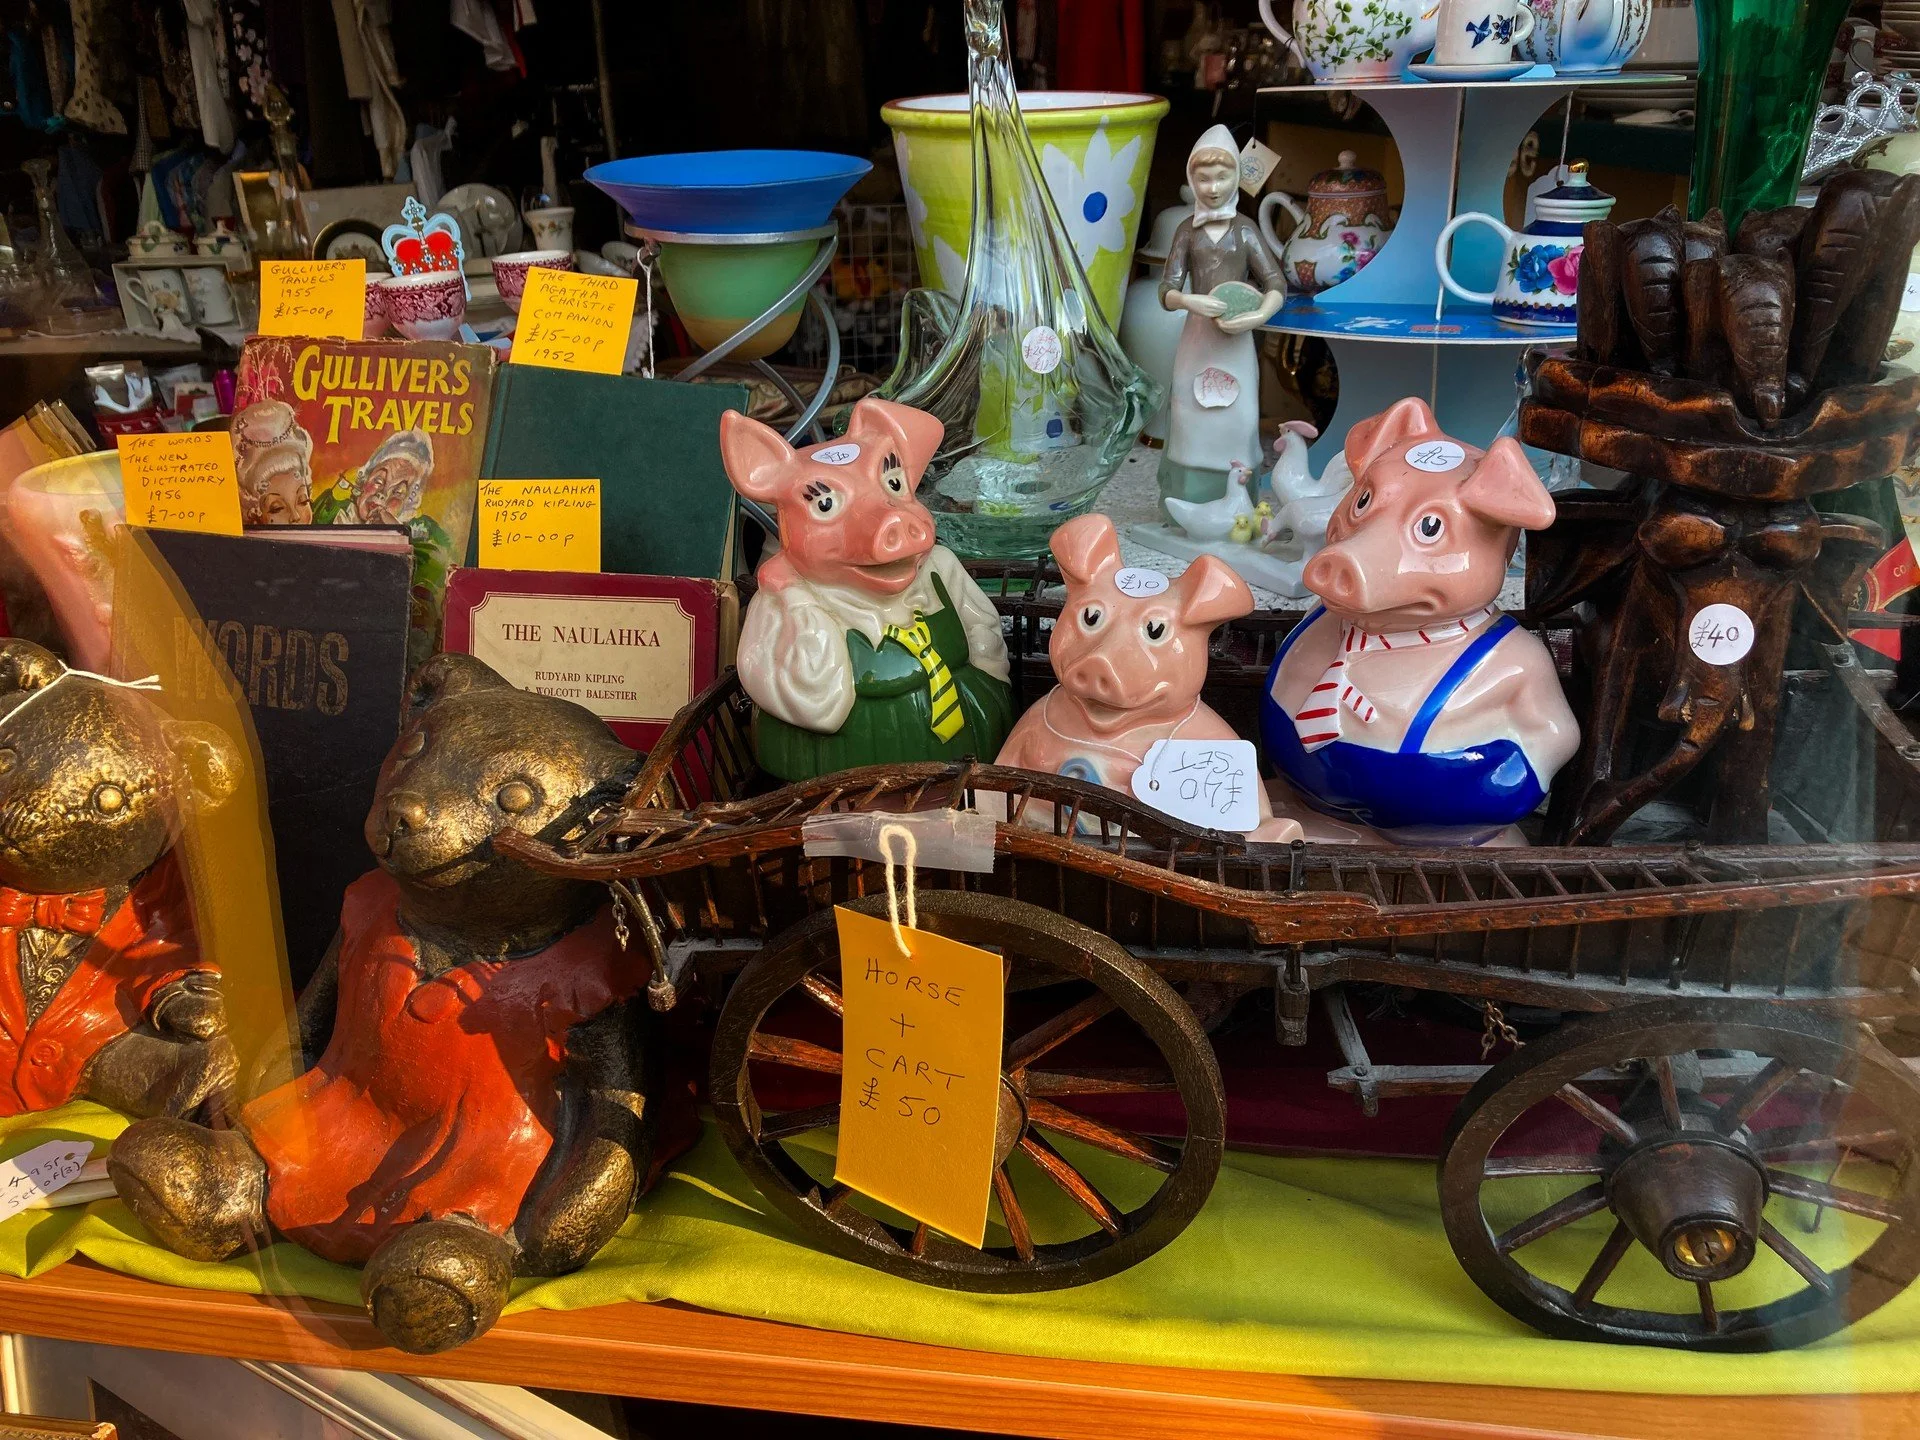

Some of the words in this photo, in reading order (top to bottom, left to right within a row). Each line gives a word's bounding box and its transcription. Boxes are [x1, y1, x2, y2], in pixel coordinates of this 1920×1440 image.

[271, 262, 346, 274] GULLIVER'S
[279, 274, 335, 284] TRAVELS
[538, 272, 566, 281] THE
[580, 276, 618, 290] THIRD
[281, 286, 315, 297] 1955
[540, 283, 599, 299] AGATHA
[273, 302, 333, 319] £15-00p
[549, 295, 616, 311] CHRISTIE
[525, 323, 604, 352] £15-00p
[533, 349, 575, 363] 1952
[293, 345, 472, 400] GULLIVER'S
[322, 395, 475, 444] TRAVELS
[129, 437, 156, 450] THE
[168, 435, 212, 446] WORDS
[125, 454, 149, 463] THE
[159, 453, 188, 461] NEW
[138, 463, 218, 473] ILLUSTRATED
[142, 475, 225, 487] DICTIONARY
[480, 482, 503, 495] THE
[522, 485, 595, 495] NAULAHKA
[149, 490, 181, 500] 1956
[485, 498, 534, 508] RUDYARD
[544, 499, 596, 508] KIPLING
[146, 505, 205, 524] £7-00p
[495, 510, 528, 522] 1950
[1121, 573, 1160, 590] £10
[502, 623, 541, 642] THE
[552, 626, 661, 647] NAULAHKA
[1691, 618, 1740, 649] £40
[172, 616, 349, 717] WORDS
[535, 671, 581, 682] RUDYARD
[586, 673, 625, 684] KIPLING
[536, 687, 581, 698] WOLCOTT
[586, 689, 637, 701] BALESTIER
[1169, 751, 1233, 773] SET
[1179, 769, 1244, 814] £40
[865, 958, 966, 1007] HORSE
[890, 1013, 915, 1038] +
[866, 1048, 965, 1090] CART
[8, 1186, 38, 1209] Set
